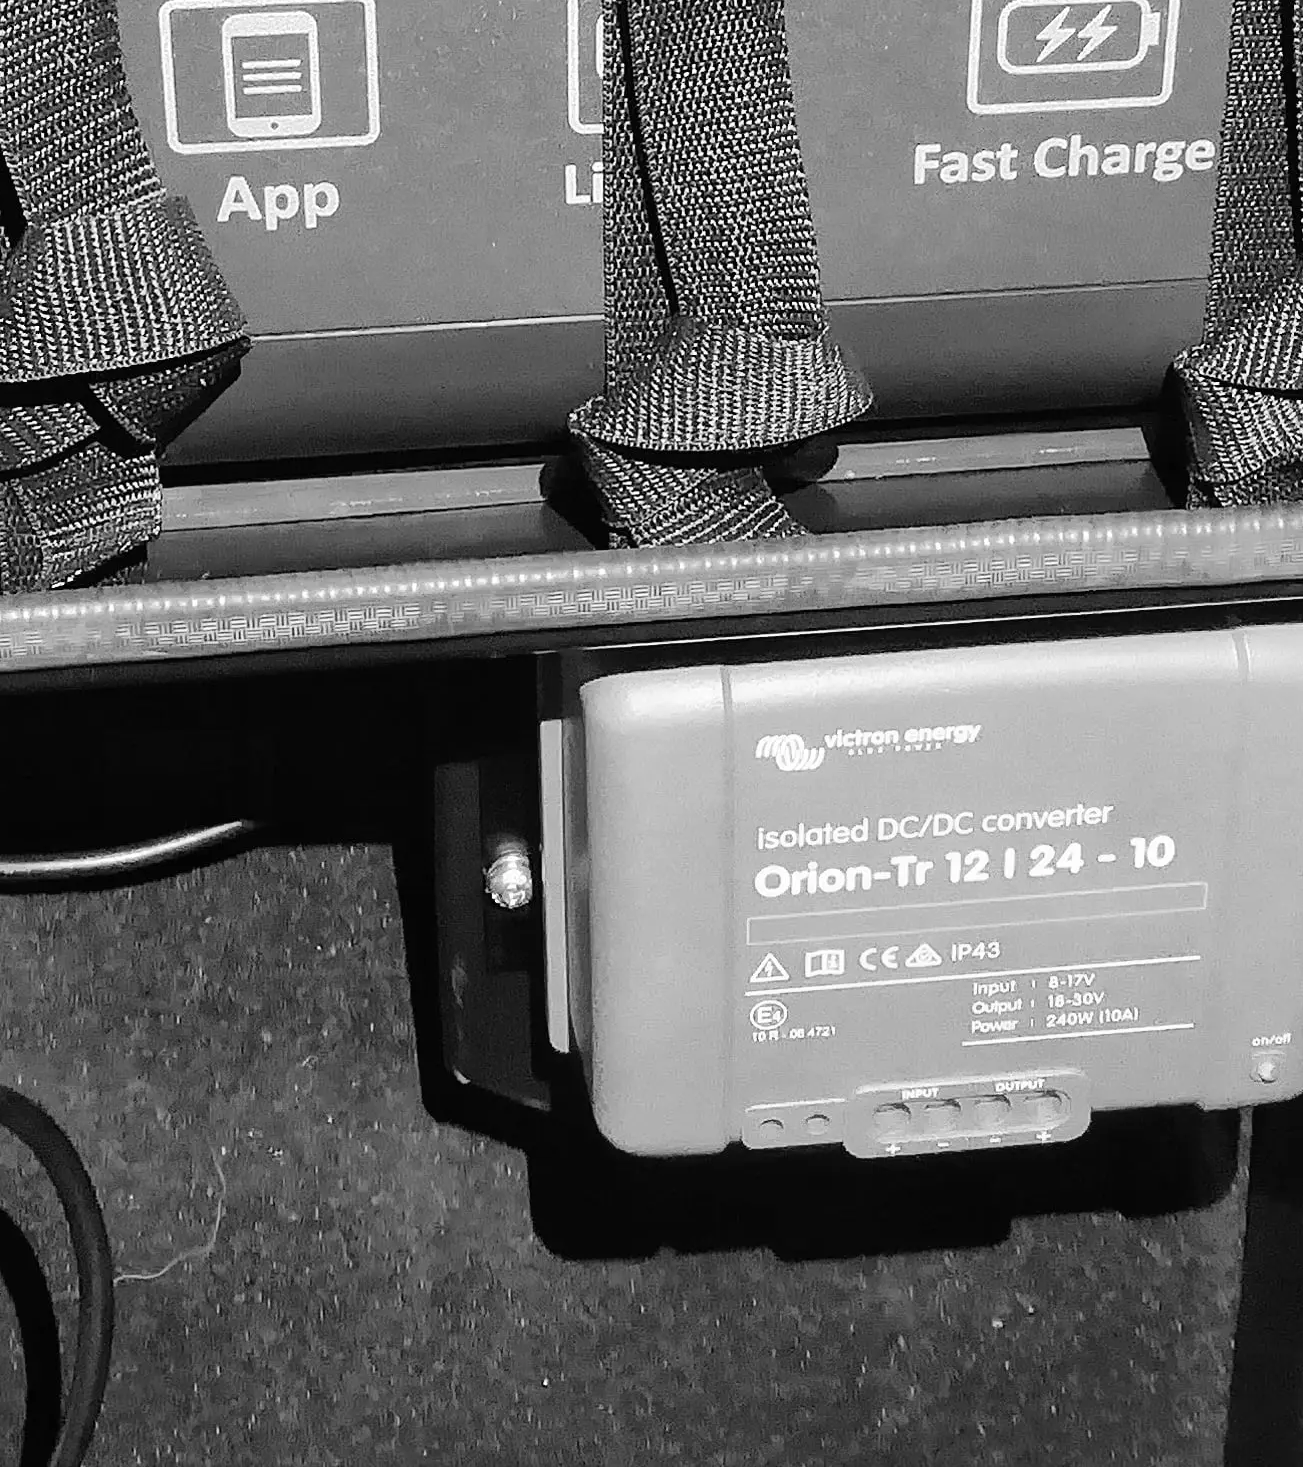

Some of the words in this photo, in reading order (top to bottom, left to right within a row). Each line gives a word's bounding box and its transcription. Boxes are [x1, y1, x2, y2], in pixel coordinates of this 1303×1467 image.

[913, 142, 1019, 185] Fast
[1033, 134, 1216, 183] Charge
[217, 175, 340, 231] App
[824, 729, 900, 749] victron
[903, 724, 982, 744] energy
[757, 818, 869, 851] isolated
[877, 811, 974, 842] DC/DC
[982, 803, 1114, 833] converter
[754, 854, 934, 898] Orion-Tr
[945, 849, 990, 885] 12
[1029, 841, 1084, 878] 24
[1130, 834, 1176, 870] 10
[951, 942, 1001, 962] IP43
[972, 980, 1017, 997] Input
[1048, 973, 1096, 990] 8-17V
[971, 998, 1022, 1015] Output
[1048, 991, 1105, 1009] 18-30V
[971, 1019, 1018, 1034] Power
[1046, 1012, 1094, 1028] 240W
[1099, 1007, 1139, 1024] (10A)
[1251, 1032, 1293, 1047] on/off
[901, 1087, 940, 1101] INPUT
[995, 1078, 1046, 1094] OUTPUT
